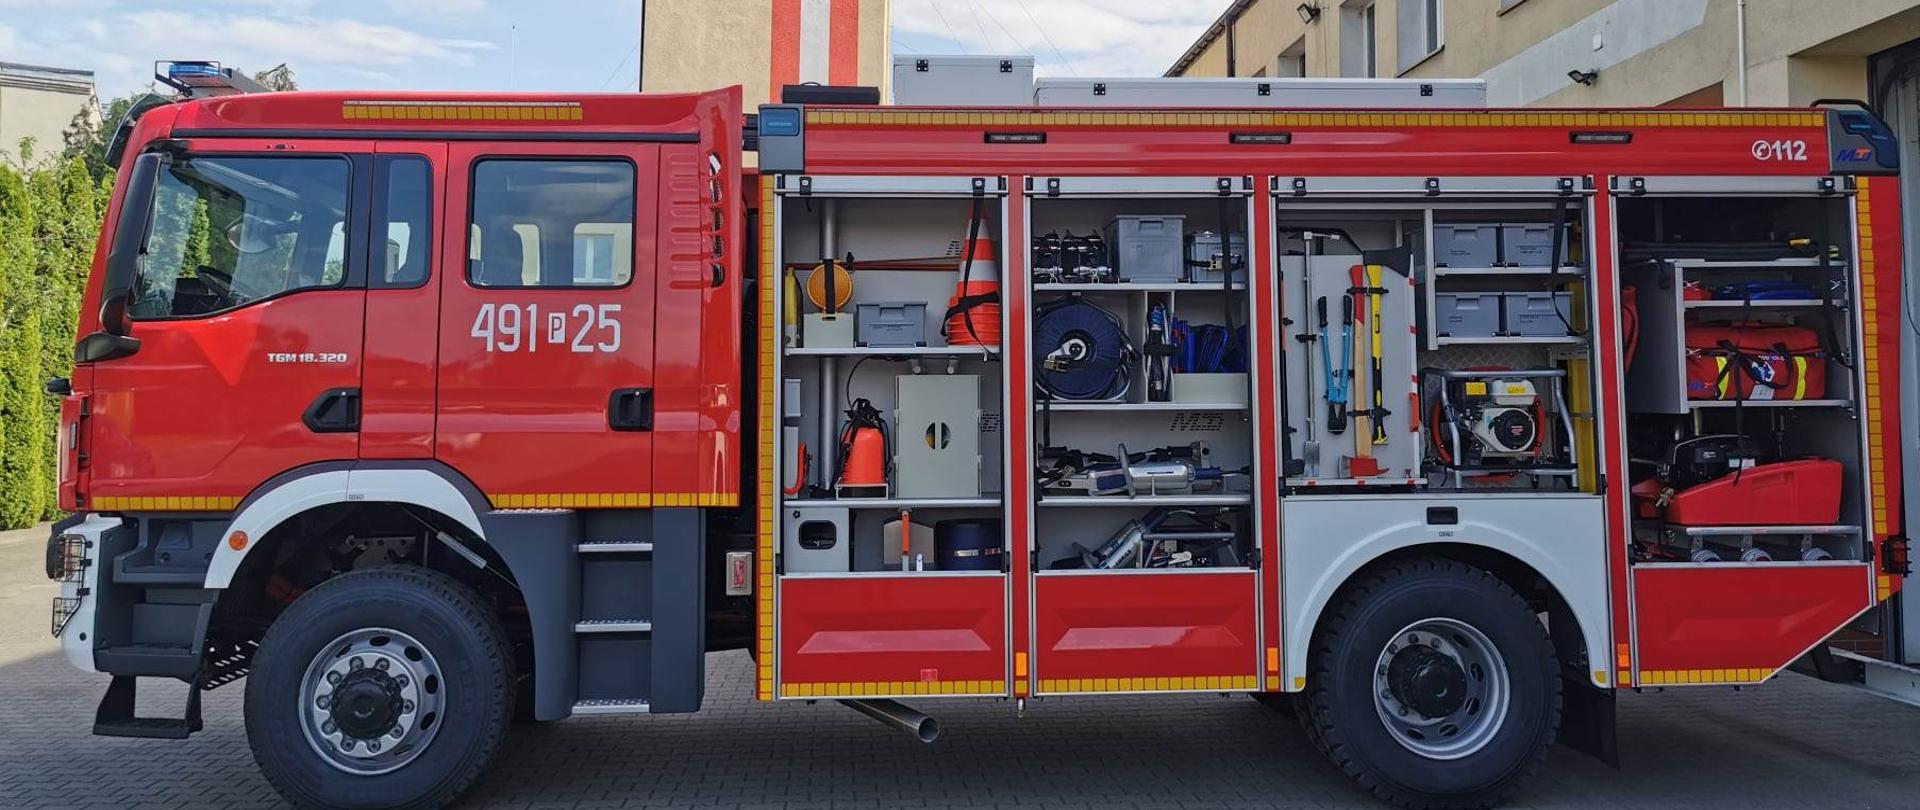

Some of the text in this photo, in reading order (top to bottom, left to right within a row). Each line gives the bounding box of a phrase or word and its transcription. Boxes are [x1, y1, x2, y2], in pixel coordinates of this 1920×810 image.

[1770, 140, 1807, 162] 112
[470, 303, 537, 352] 491
[571, 303, 622, 352] 25
[267, 353, 348, 363] TGM 18.320
